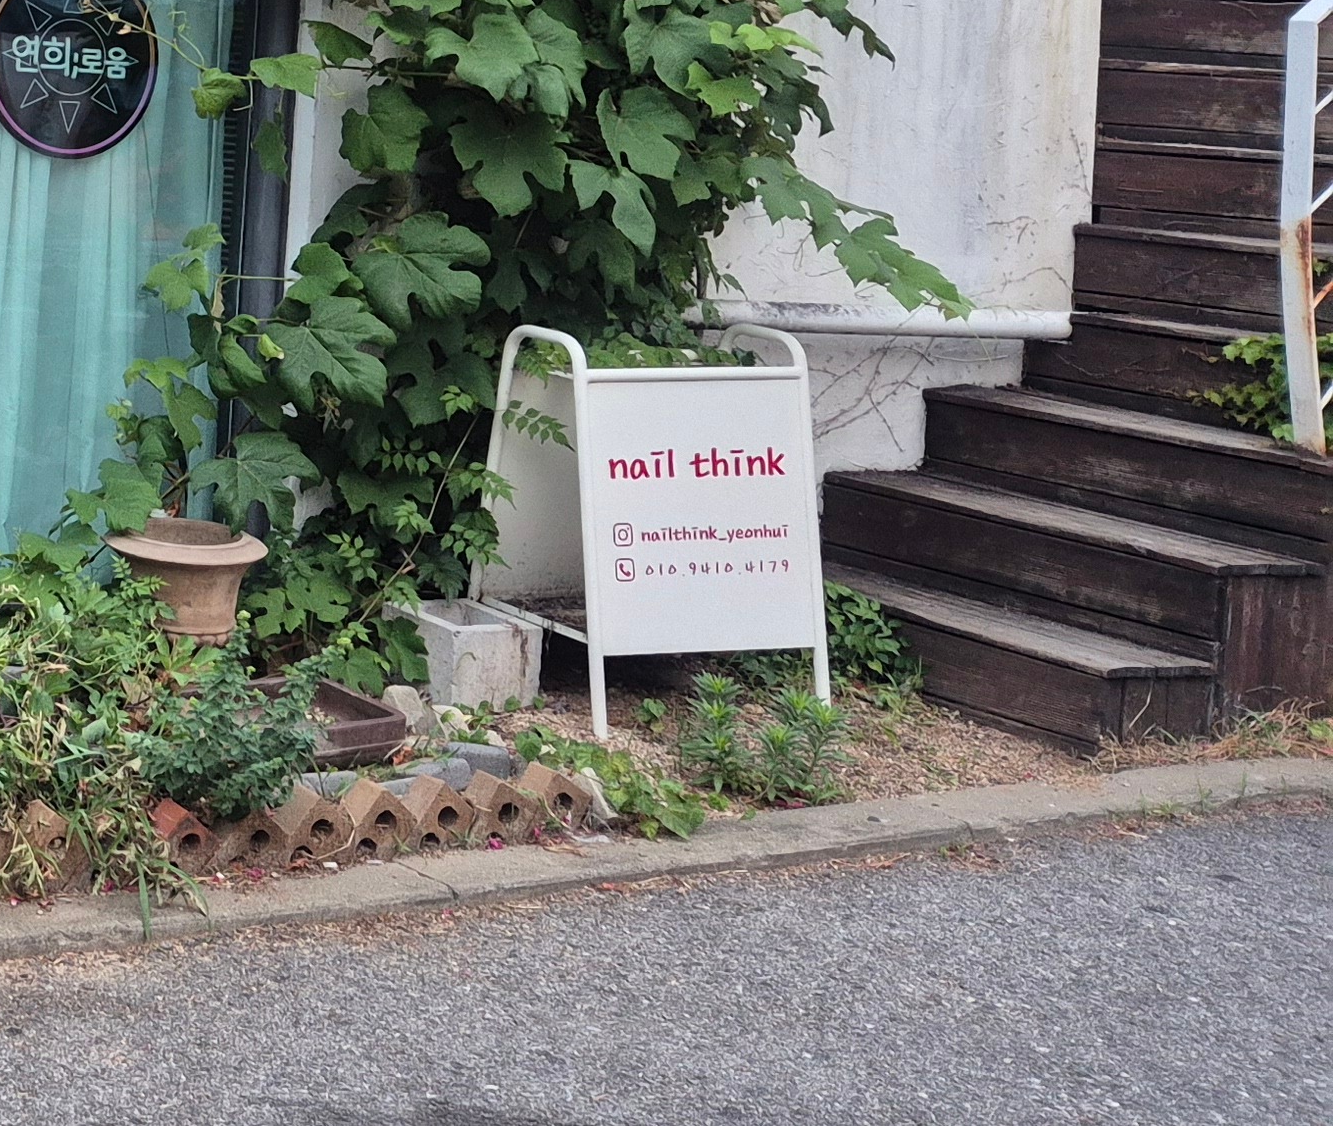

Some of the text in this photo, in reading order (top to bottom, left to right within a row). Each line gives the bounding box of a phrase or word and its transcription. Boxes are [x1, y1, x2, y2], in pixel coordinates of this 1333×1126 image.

[11, 34, 131, 80] 연희;로움
[608, 446, 787, 480] nail think
[640, 524, 789, 544] nailthink_yeonhui
